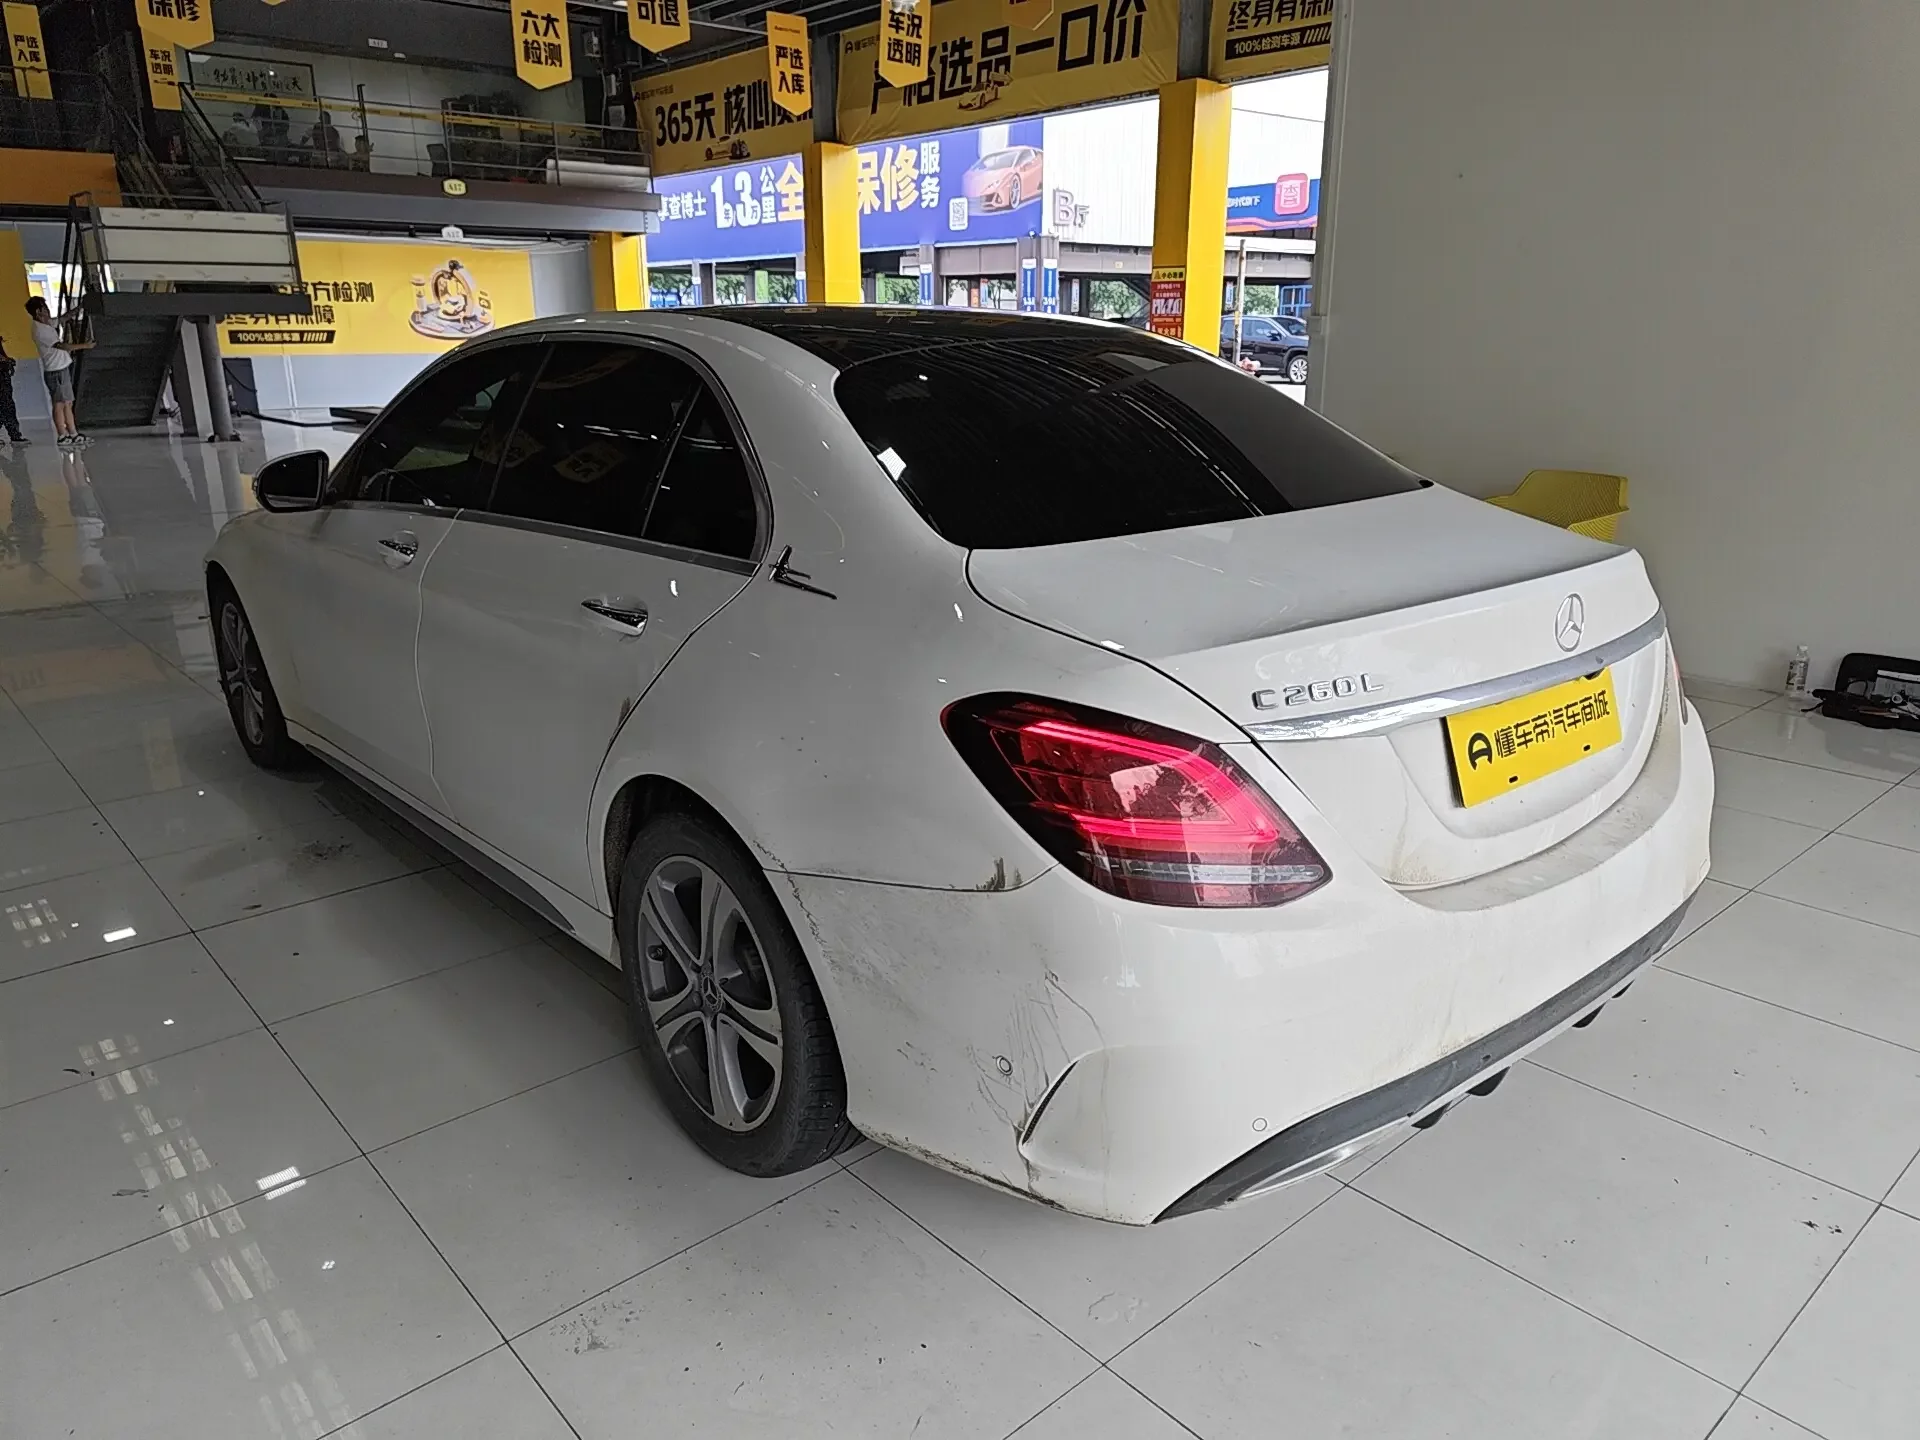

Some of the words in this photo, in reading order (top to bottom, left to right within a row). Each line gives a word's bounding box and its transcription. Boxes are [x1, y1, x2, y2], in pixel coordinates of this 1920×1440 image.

[521, 9, 561, 39] 六大
[888, 10, 923, 39] 车况
[13, 34, 39, 49] 严选
[17, 49, 41, 63] 入库
[523, 39, 563, 68] 检测
[887, 36, 921, 67] 透明
[775, 45, 804, 70] 严选
[778, 70, 805, 95] 入库
[655, 91, 717, 147] 365天
[723, 79, 813, 135] 核心
[1496, 689, 1611, 759] 懂车帝汽车商城
